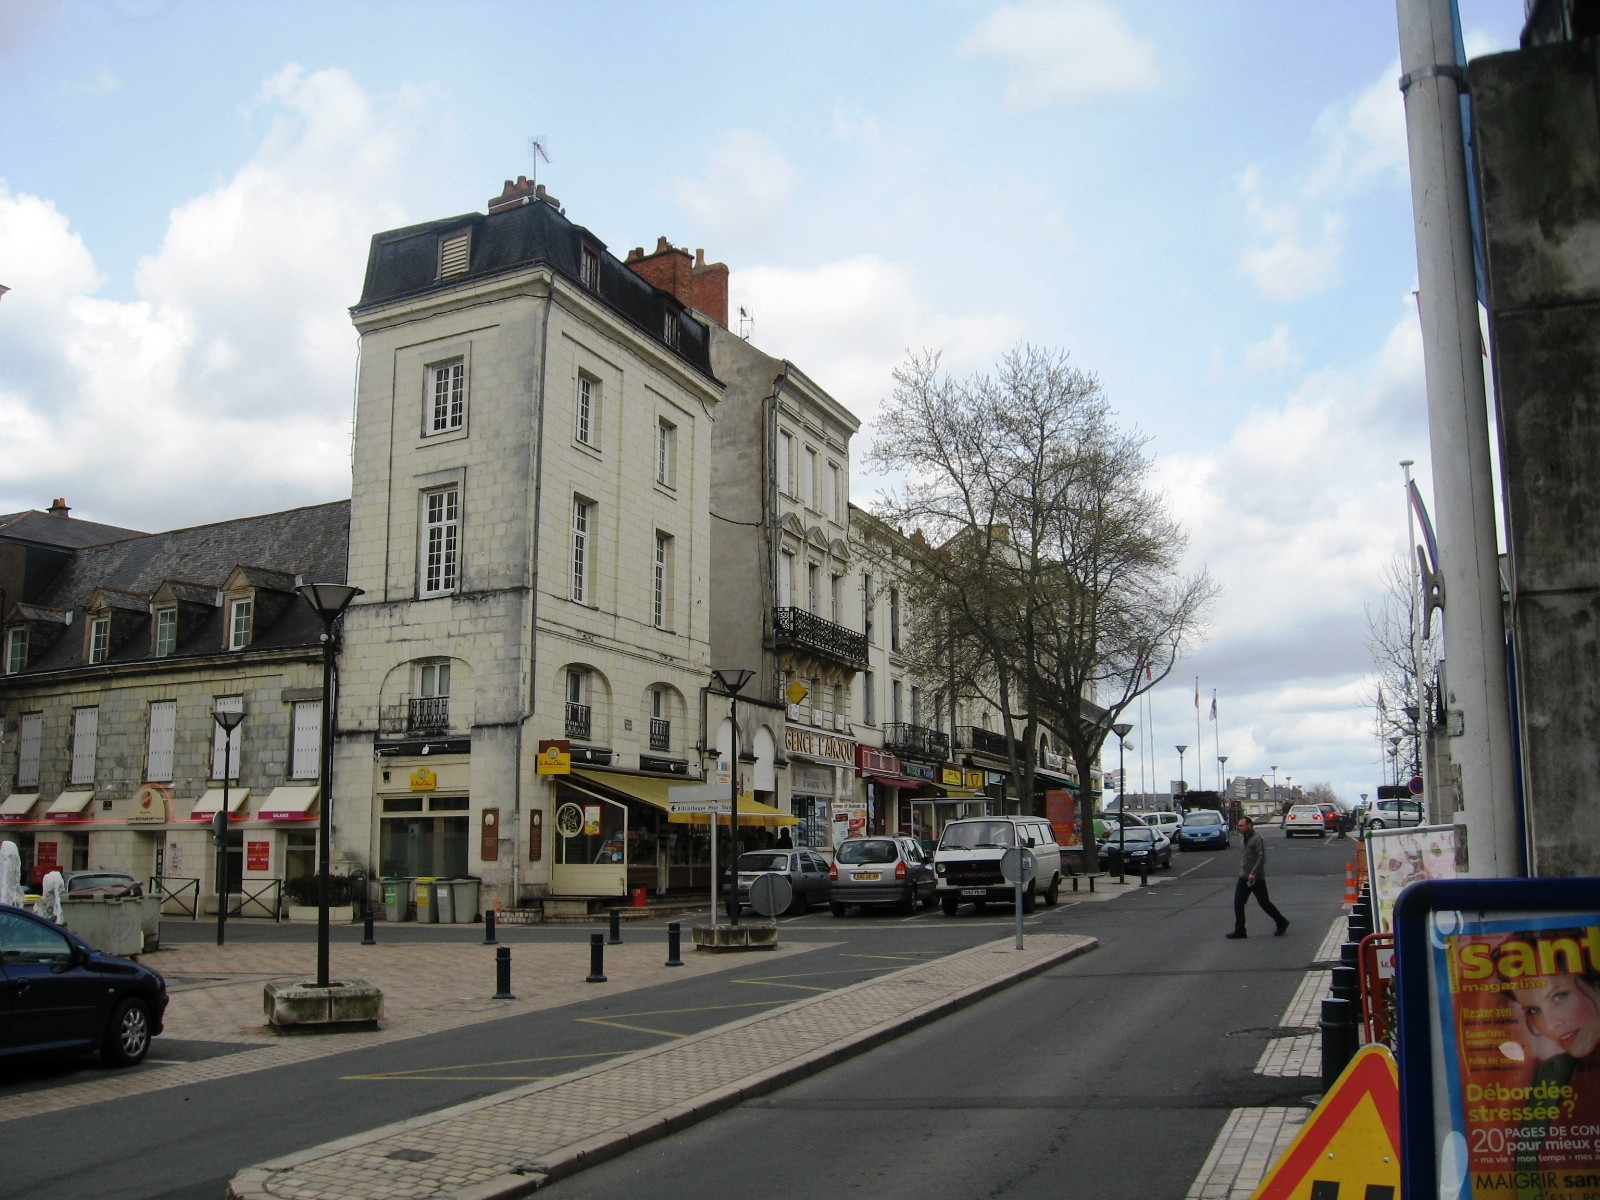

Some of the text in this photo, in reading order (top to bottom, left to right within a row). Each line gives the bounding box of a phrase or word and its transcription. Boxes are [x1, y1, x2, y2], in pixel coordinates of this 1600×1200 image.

[1462, 981, 1547, 993] magazine
[1462, 1007, 1512, 1019] Rester zen
[1465, 1079, 1578, 1102] Débordée,
[1467, 1101, 1560, 1122] stressée
[1471, 1127, 1505, 1153] 20
[1504, 1126, 1546, 1138] PAGES
[1549, 1125, 1567, 1136] DE
[1506, 1140, 1542, 1155] pour
[1545, 1136, 1591, 1150] mieux
[1495, 1155, 1509, 1163] vie
[1517, 1155, 1537, 1163] mon
[1538, 1153, 1566, 1163] temps
[1574, 1152, 1593, 1160] mes
[1476, 1171, 1559, 1190] MAIGRIR
